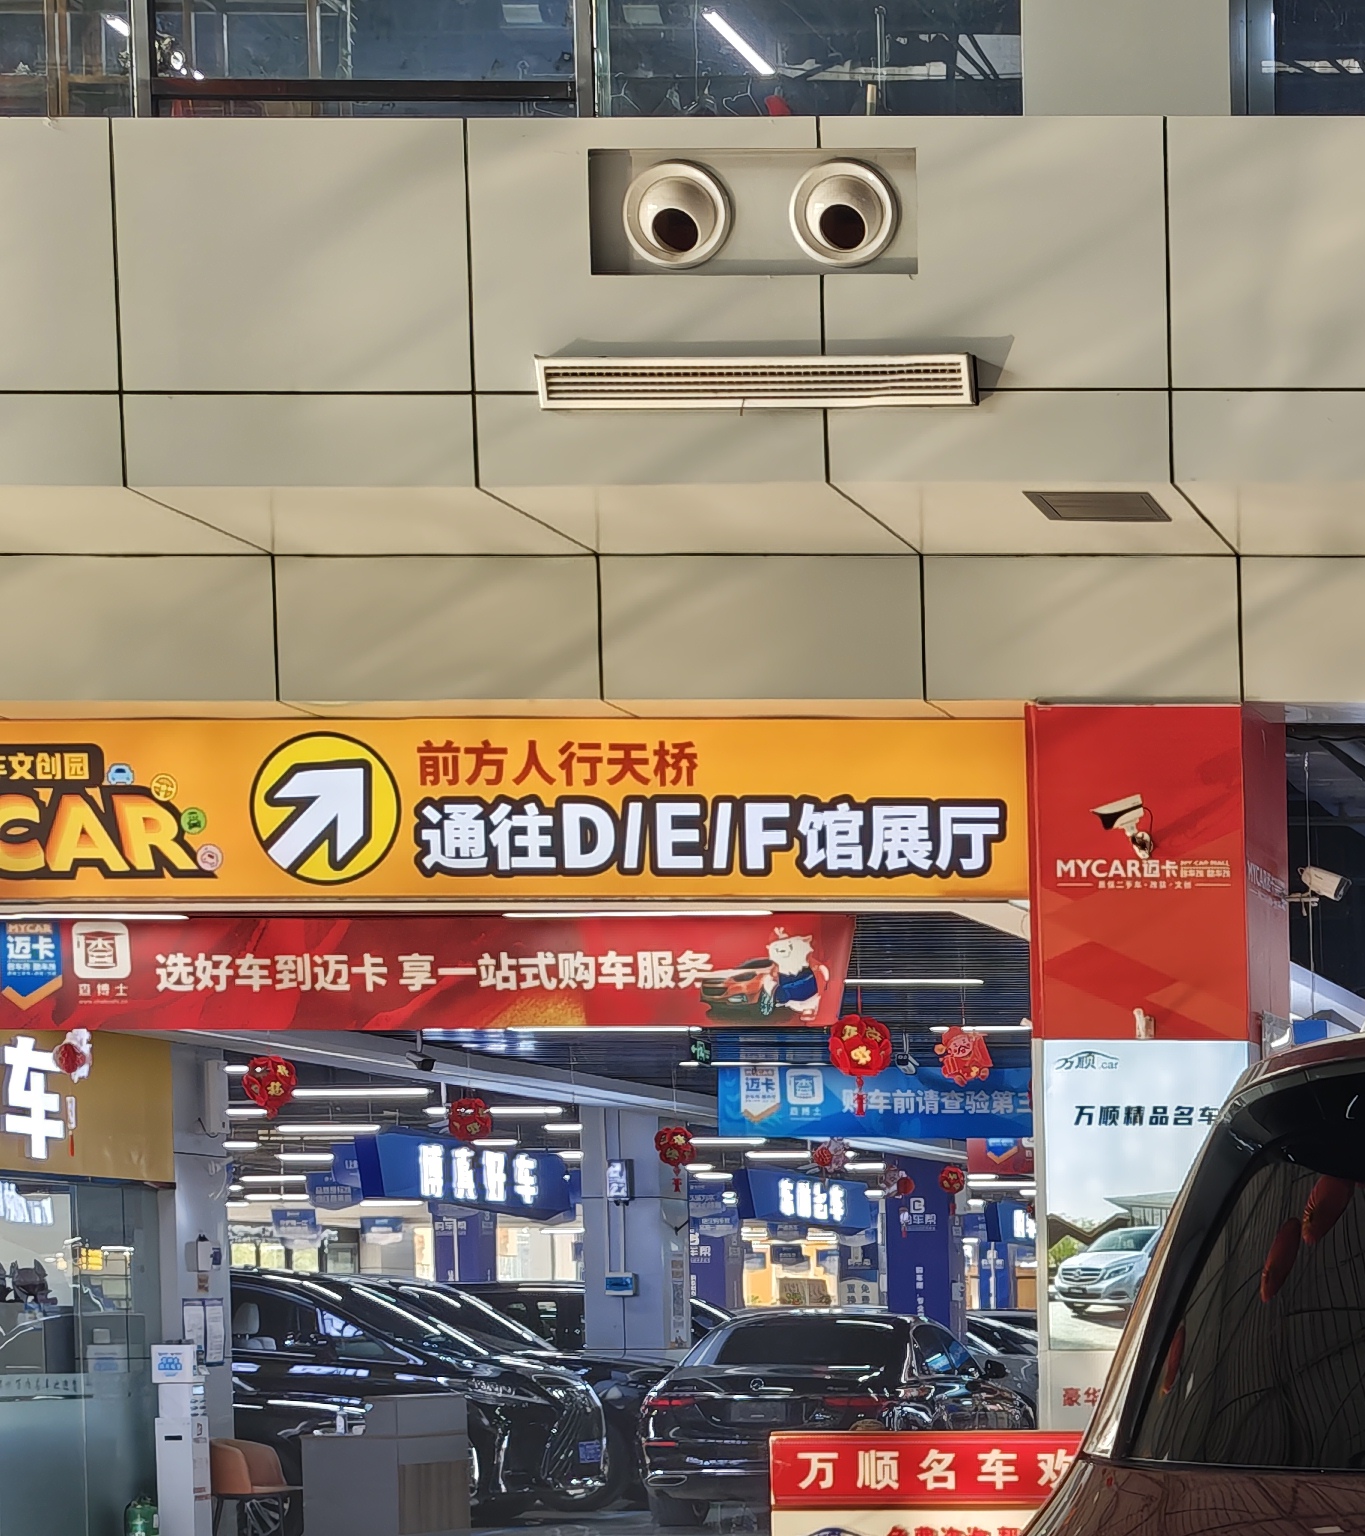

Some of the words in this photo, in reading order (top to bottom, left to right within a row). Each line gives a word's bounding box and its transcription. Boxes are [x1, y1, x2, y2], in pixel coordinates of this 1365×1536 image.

[0, 752, 90, 780] 文创园
[416, 739, 699, 787] 前方人行天桥
[420, 801, 1001, 872] 通往D/E/F馆展厅
[6, 935, 56, 960] 迈卡
[155, 952, 388, 993] 选好车到迈卡
[397, 950, 714, 993] 享一站式购车服务
[1074, 1105, 1221, 1126] 万顺精品名车
